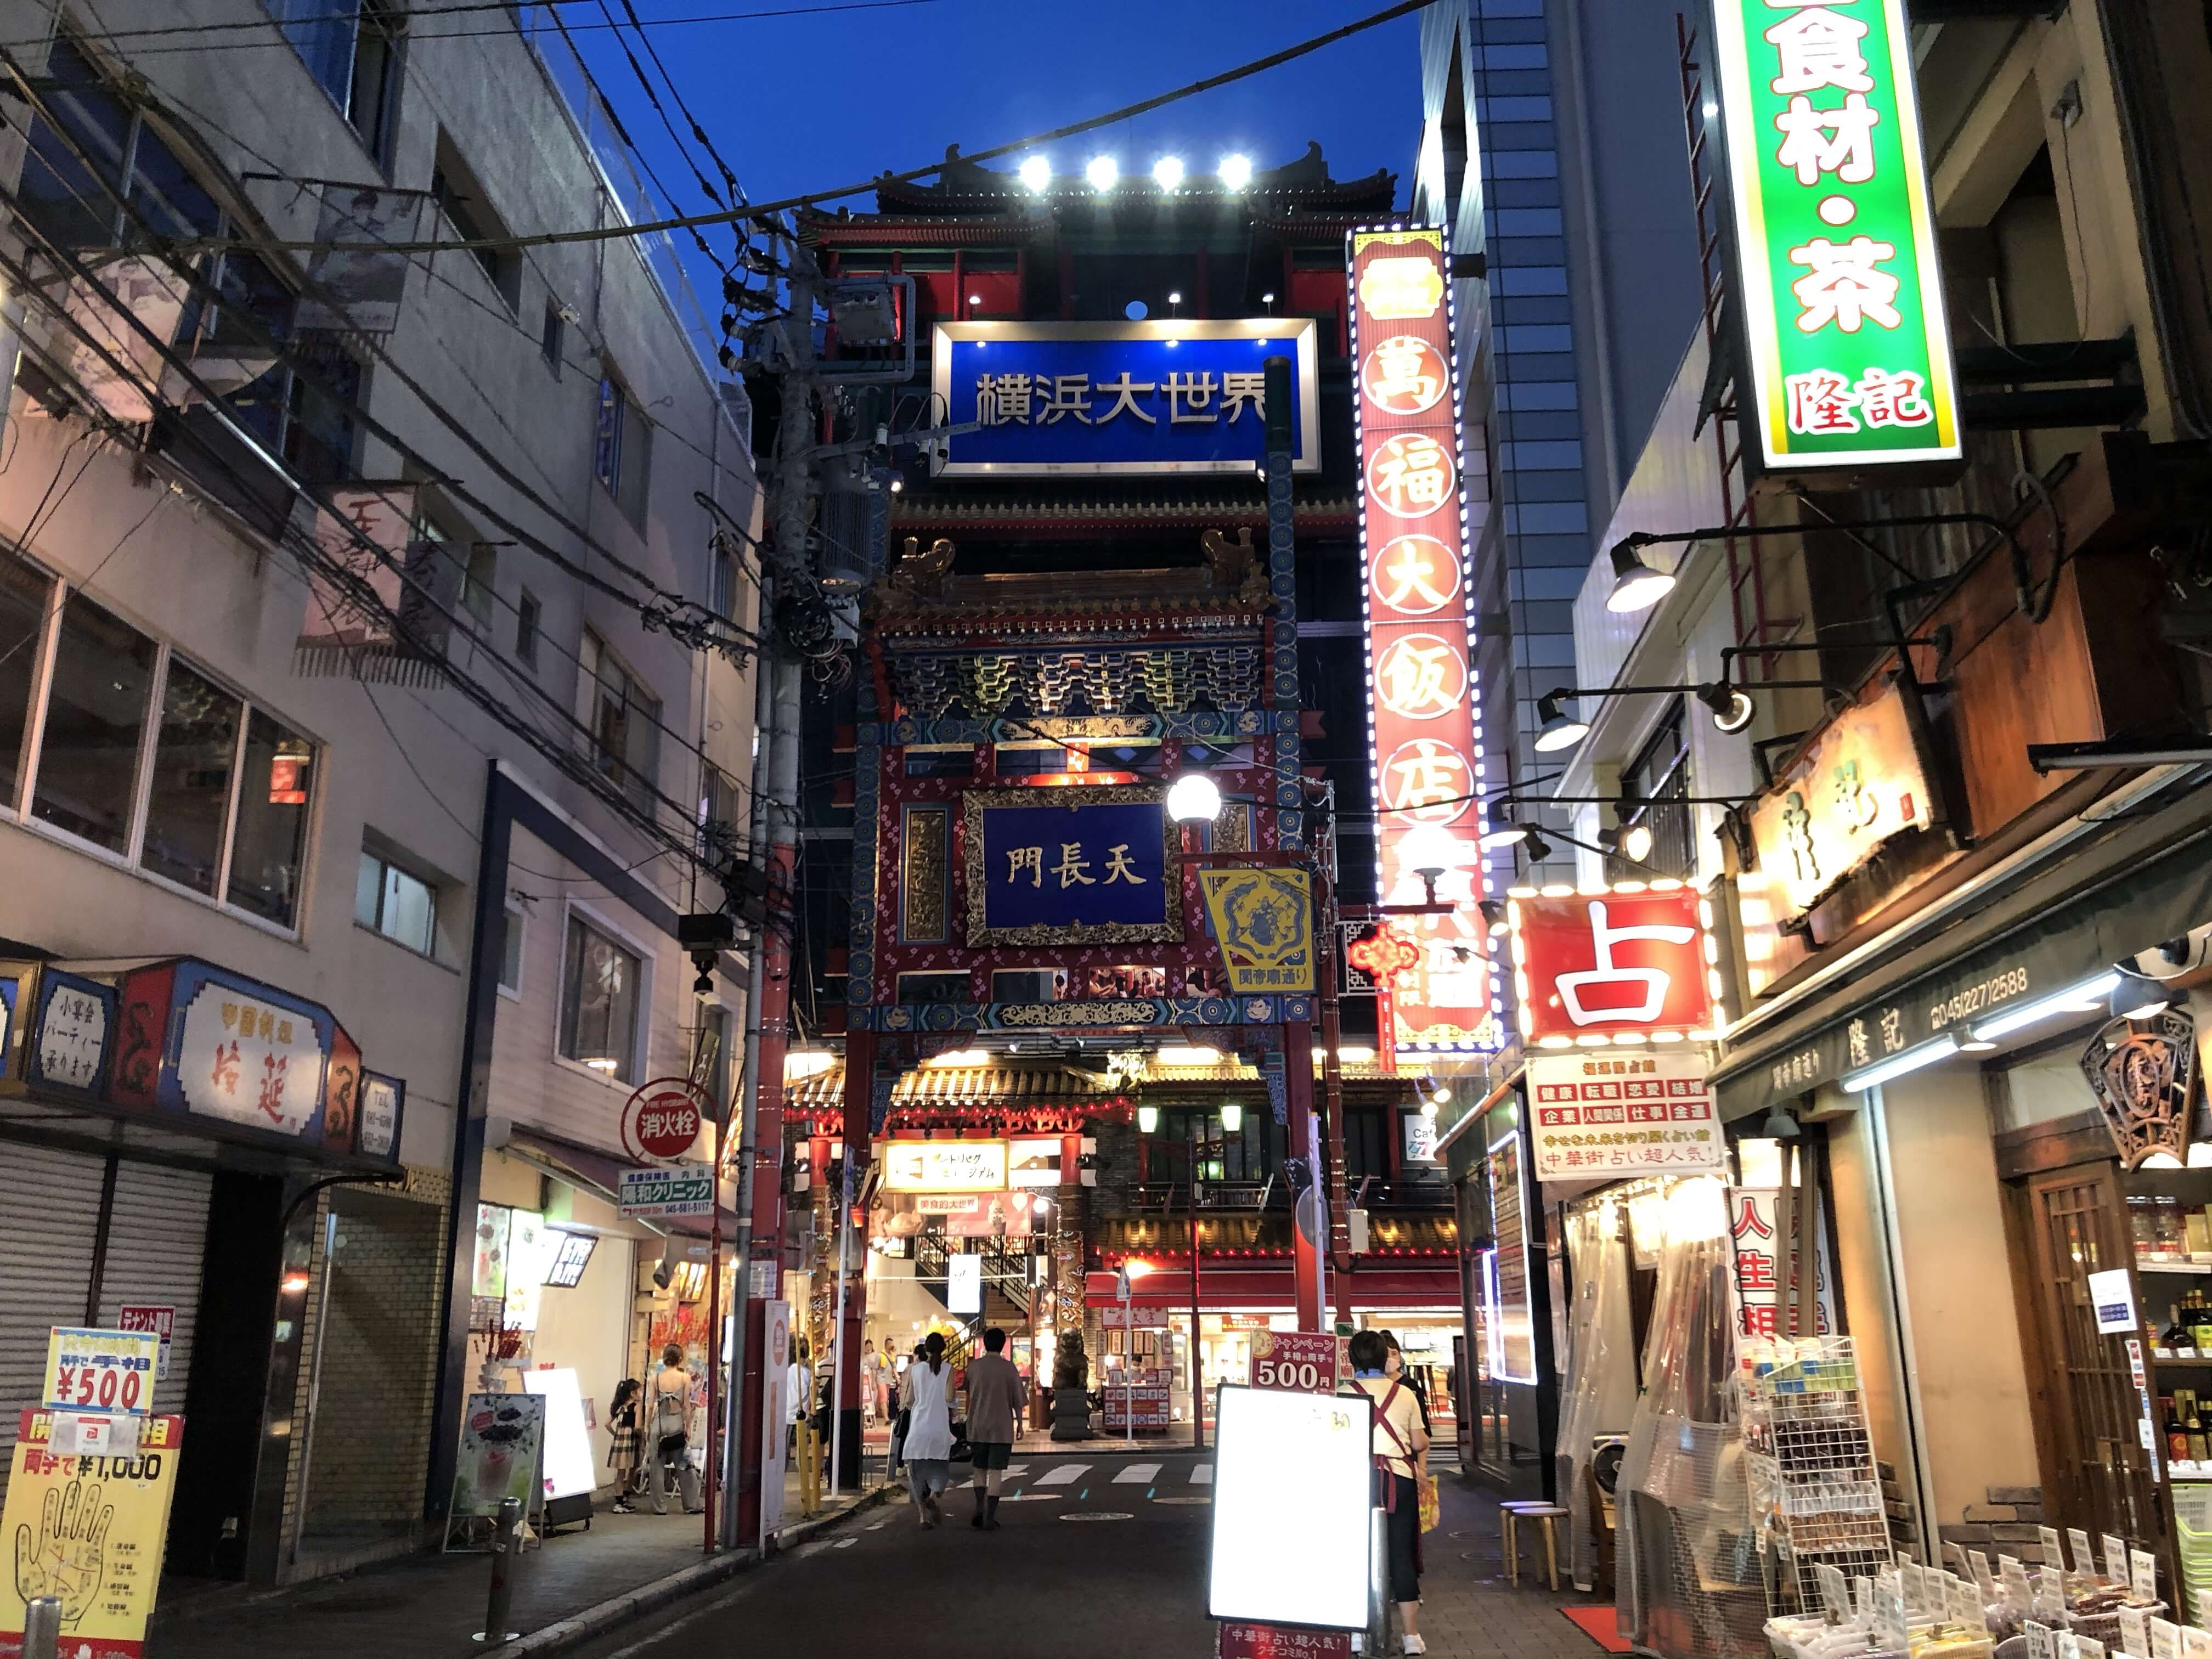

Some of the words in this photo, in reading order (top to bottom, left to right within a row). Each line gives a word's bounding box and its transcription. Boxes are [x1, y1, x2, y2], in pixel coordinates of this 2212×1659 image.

[1762, 0, 1904, 334] 食材・茶
[977, 372, 1266, 425] 横浜大世界
[1790, 370, 1932, 433] 隆記
[1372, 336, 1463, 819] 萬福大飯店
[1554, 900, 1696, 1028] 占
[59, 995, 94, 1024] 小宴会
[1848, 1007, 1904, 1068] 隆記
[47, 1049, 92, 1077] 承ります
[1541, 1086, 1573, 1101] 健康
[1585, 1084, 1619, 1099] 転職
[1627, 1082, 1661, 1097] 恋愛
[1671, 1080, 1704, 1095] 結婚
[641, 1110, 696, 1139] 消火栓
[1544, 1109, 1576, 1124] 企業
[1584, 1107, 1624, 1122] 人間関係
[1632, 1106, 1663, 1120] 仕事
[1673, 1104, 1706, 1119] 金運
[627, 1171, 670, 1183] 健康保険医
[920, 1199, 975, 1210] 美食的大世界
[1272, 1335, 1335, 1353] キャンペーン
[57, 1366, 140, 1409] ¥500
[1257, 1361, 1330, 1390] 500円
[23, 1448, 75, 1476] 両手で
[78, 1454, 162, 1482] ¥1,000
